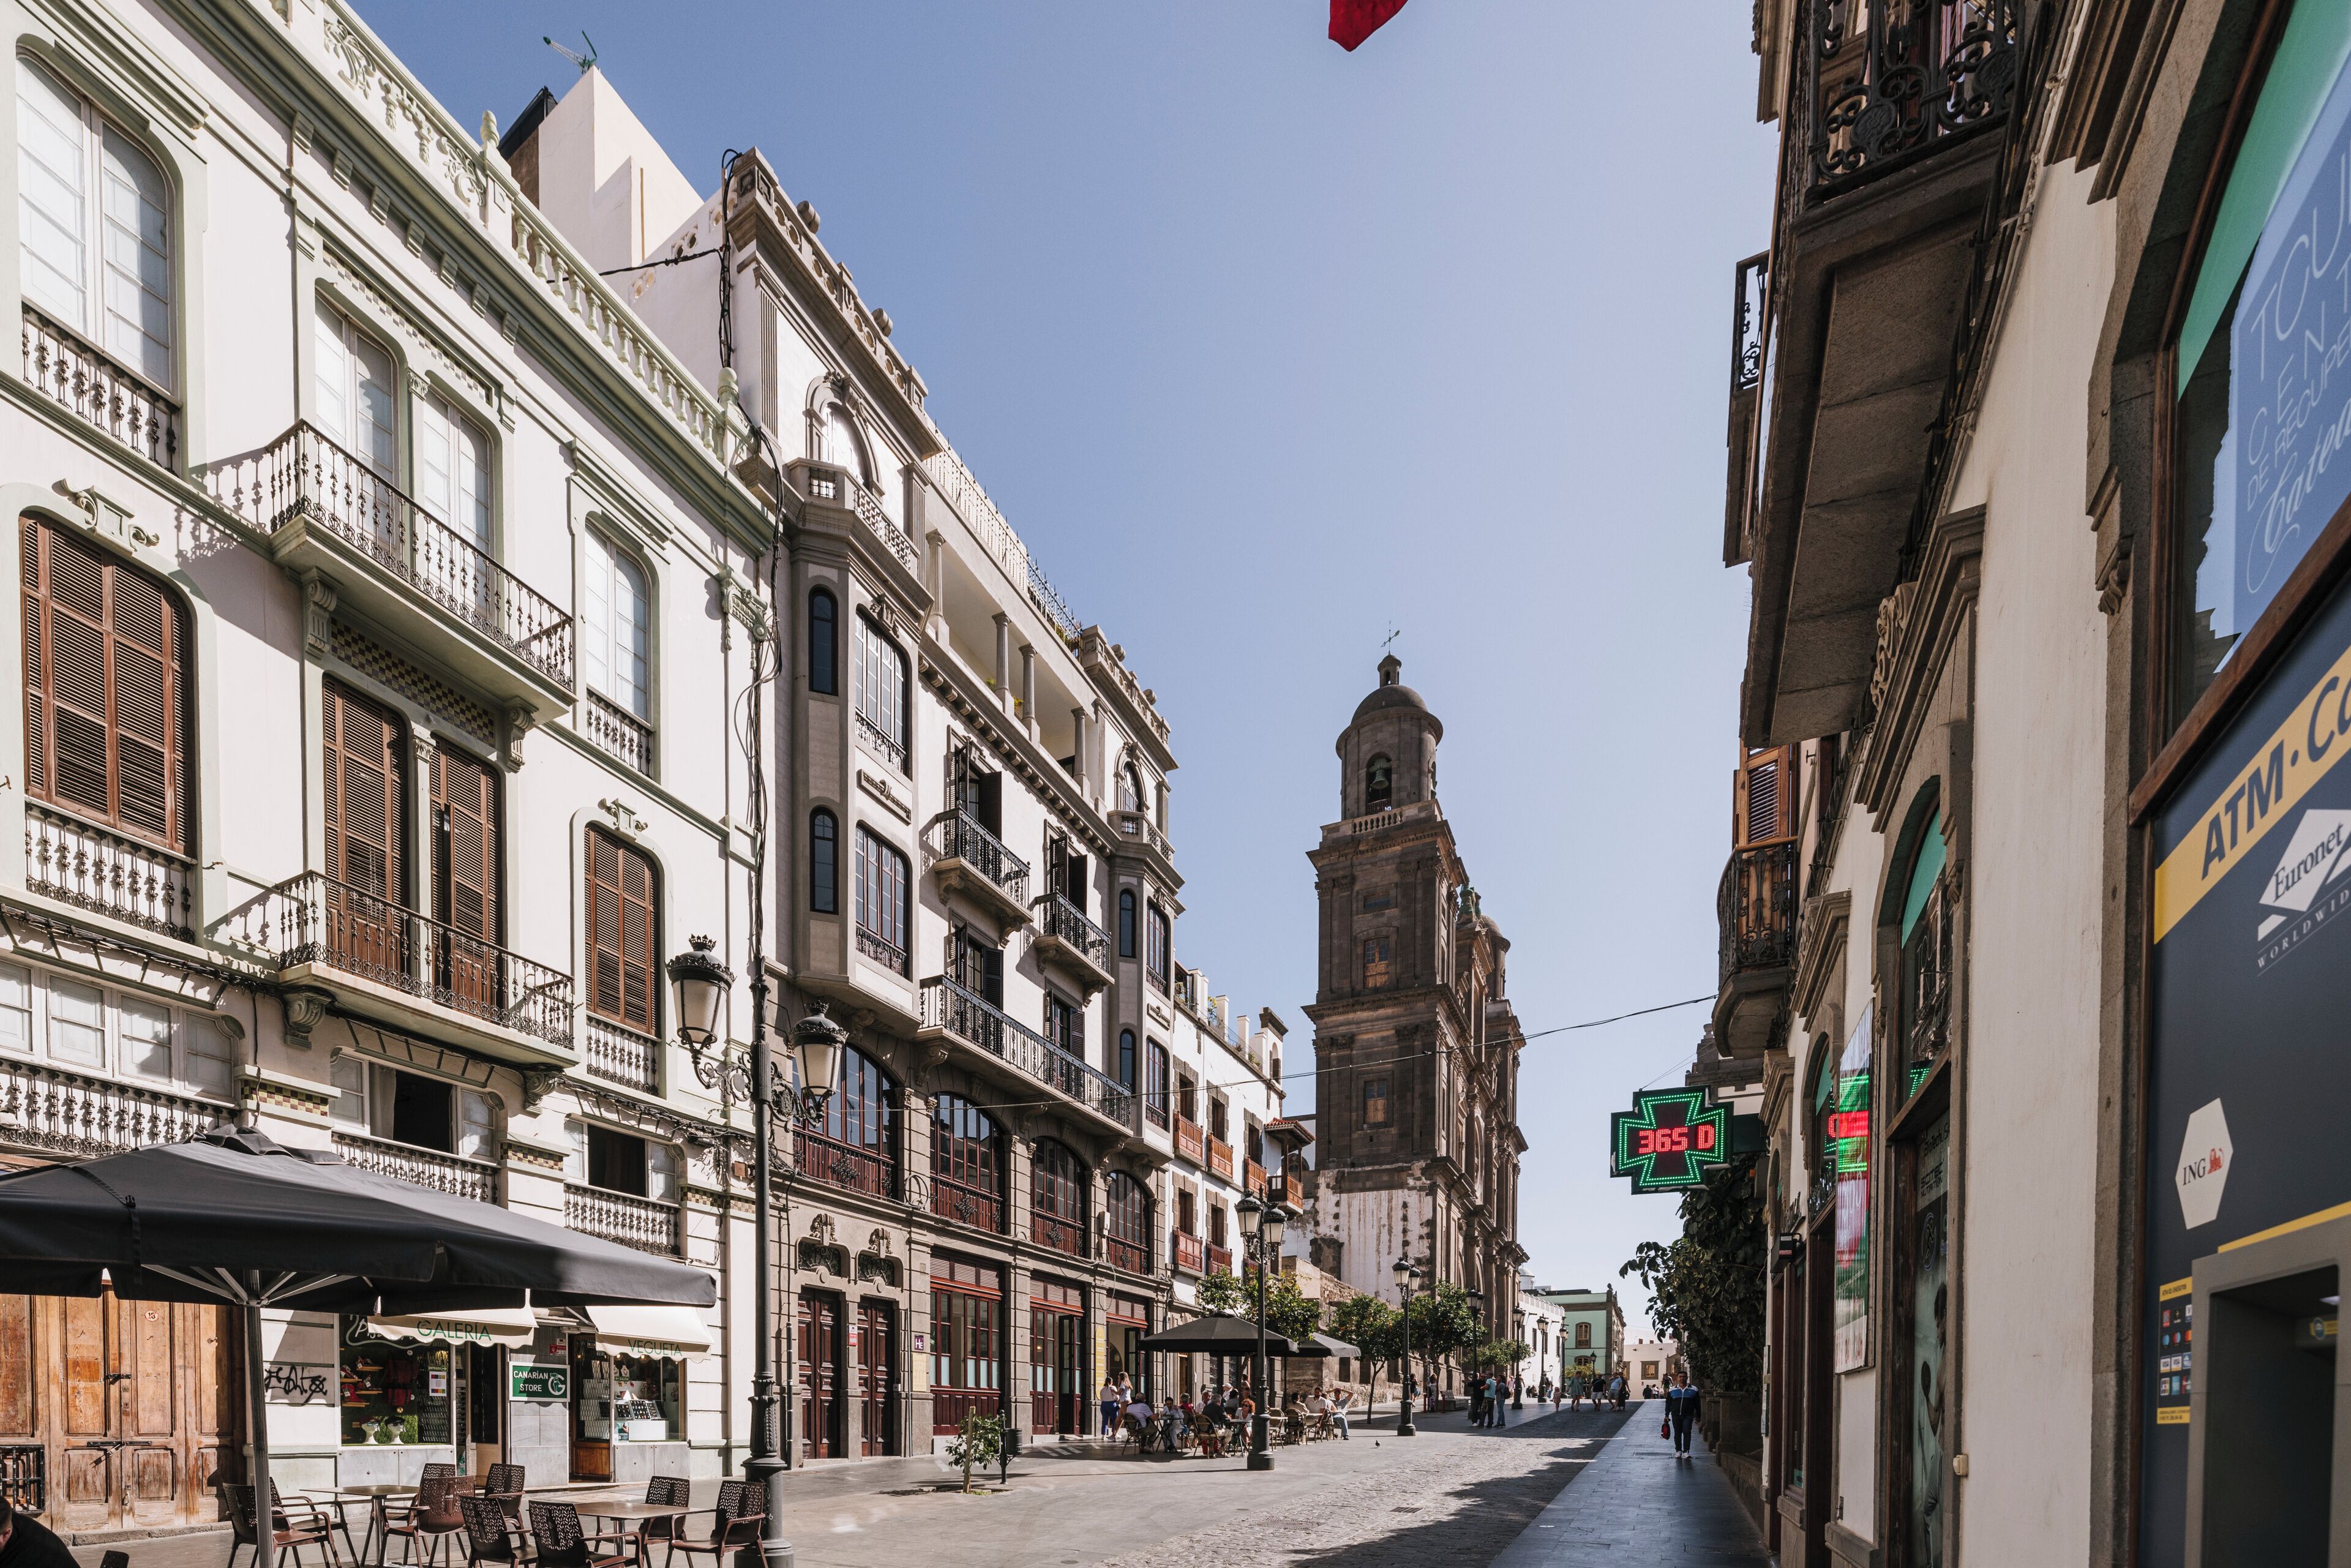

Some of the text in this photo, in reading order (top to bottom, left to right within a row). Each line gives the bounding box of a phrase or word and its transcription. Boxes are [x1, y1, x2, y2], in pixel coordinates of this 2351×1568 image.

[2248, 316, 2351, 512] DE RECUPE
[2273, 822, 2344, 903] Euronet
[1638, 1125, 1715, 1153] 365 D
[2183, 1158, 2206, 1185] ING
[417, 1320, 492, 1341] GALERÍA
[628, 1339, 683, 1357] VEGUETA
